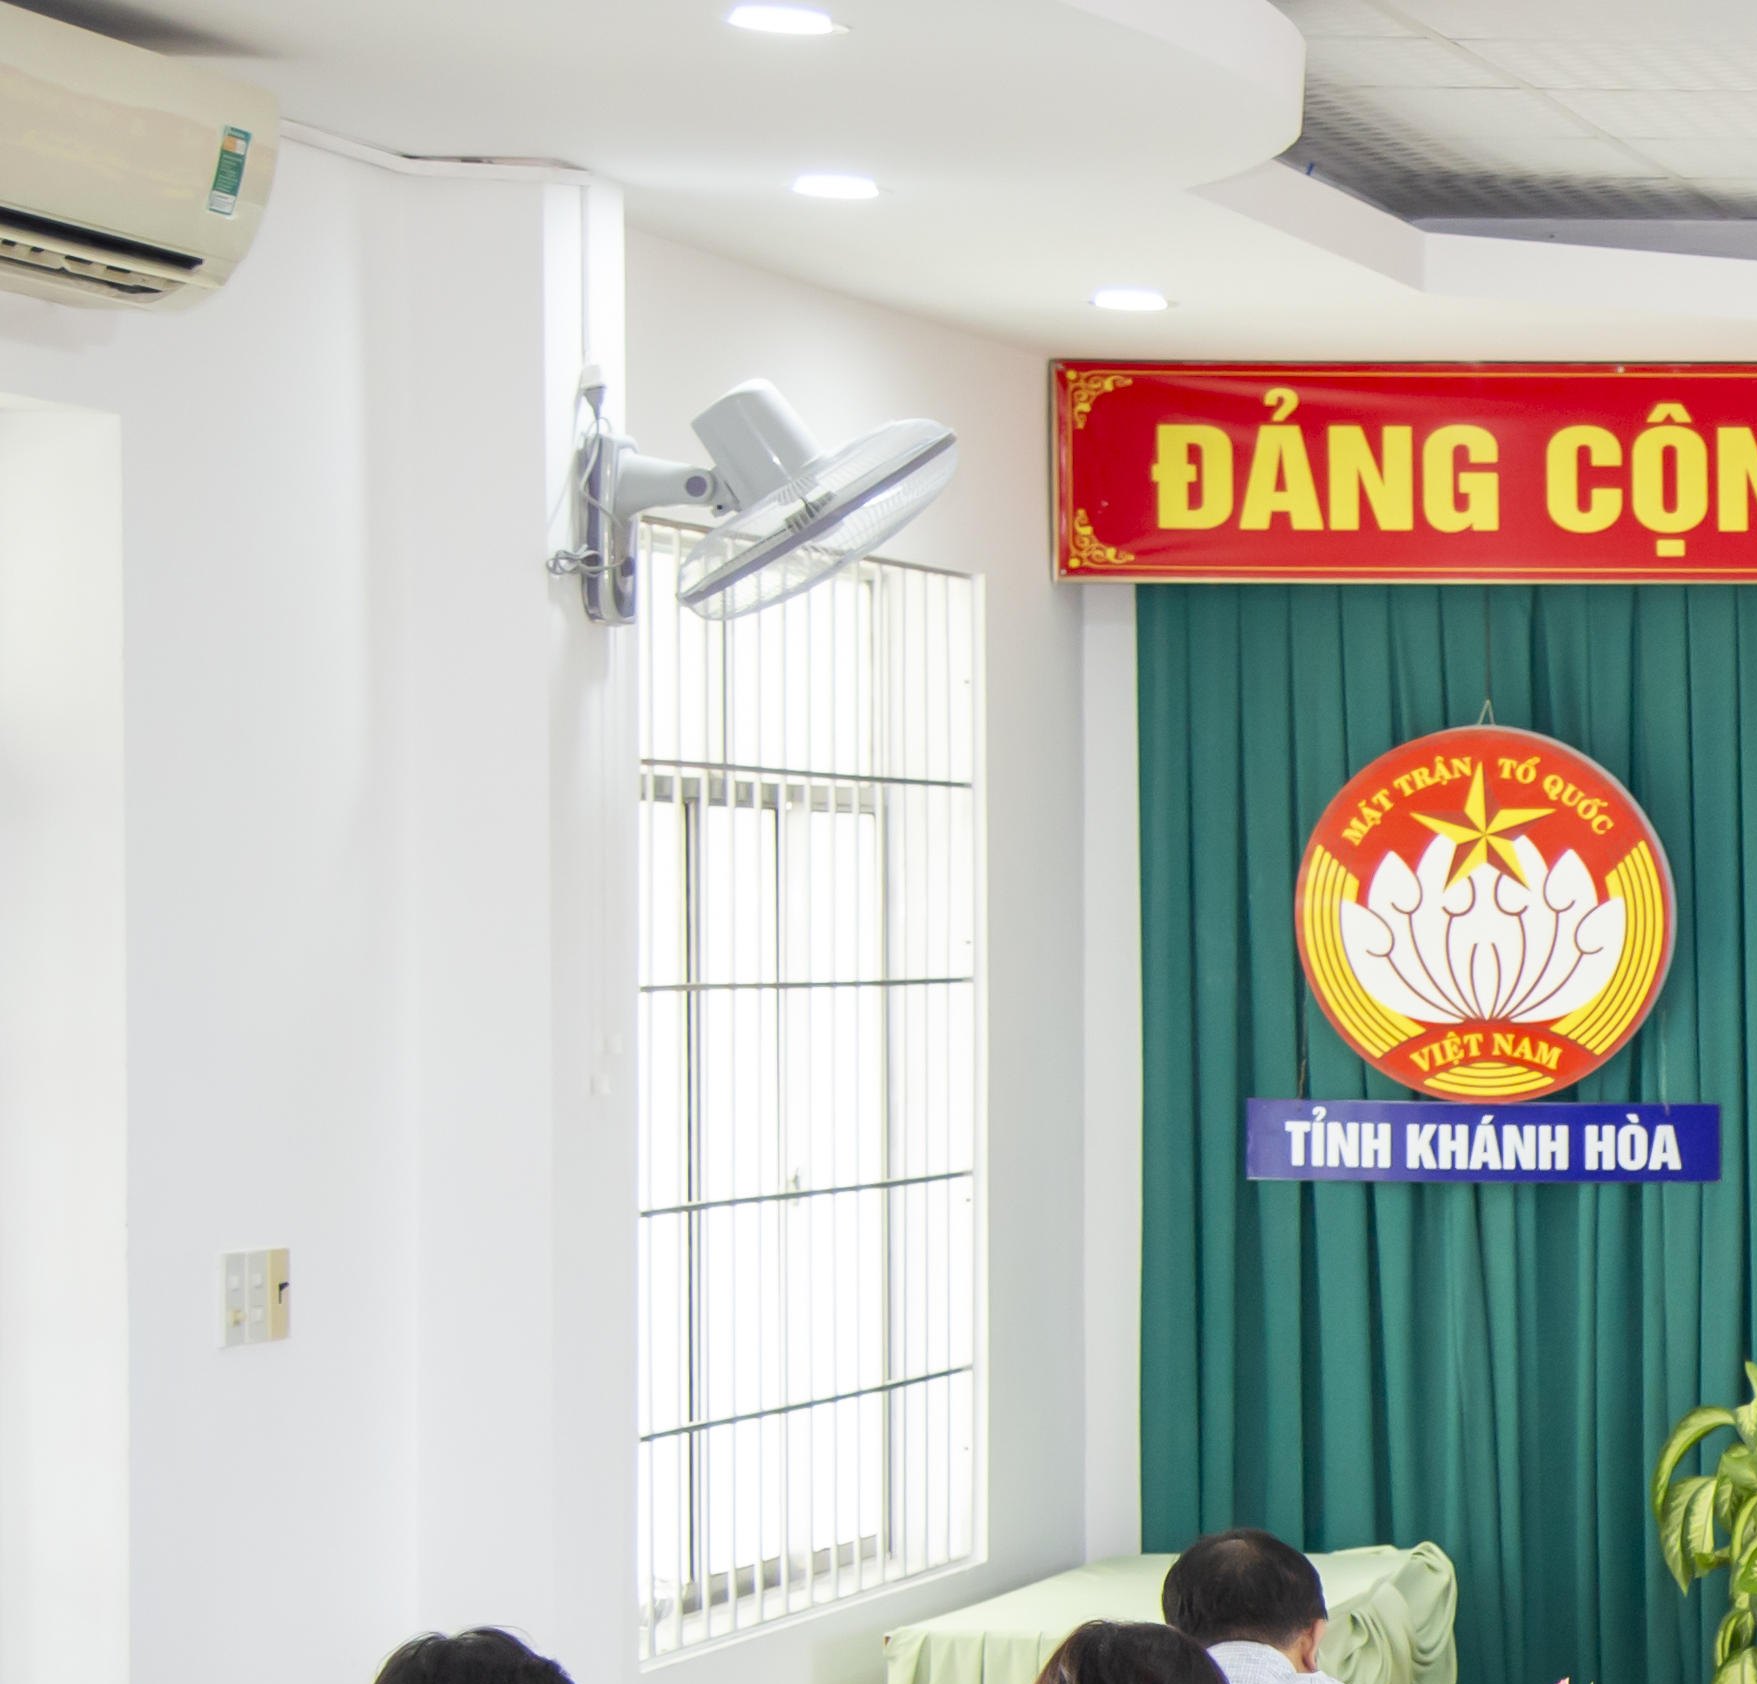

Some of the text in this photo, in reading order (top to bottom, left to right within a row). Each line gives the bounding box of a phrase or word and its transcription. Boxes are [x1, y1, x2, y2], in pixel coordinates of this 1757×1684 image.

[1152, 388, 1499, 533] ĐẢNG
[1342, 755, 1615, 847] MẶT TRẬN TỔ QUỐC
[1409, 1031, 1564, 1073] VIỆT NAM
[1284, 1106, 1683, 1171] TỈNH KHÁNH HÒA
